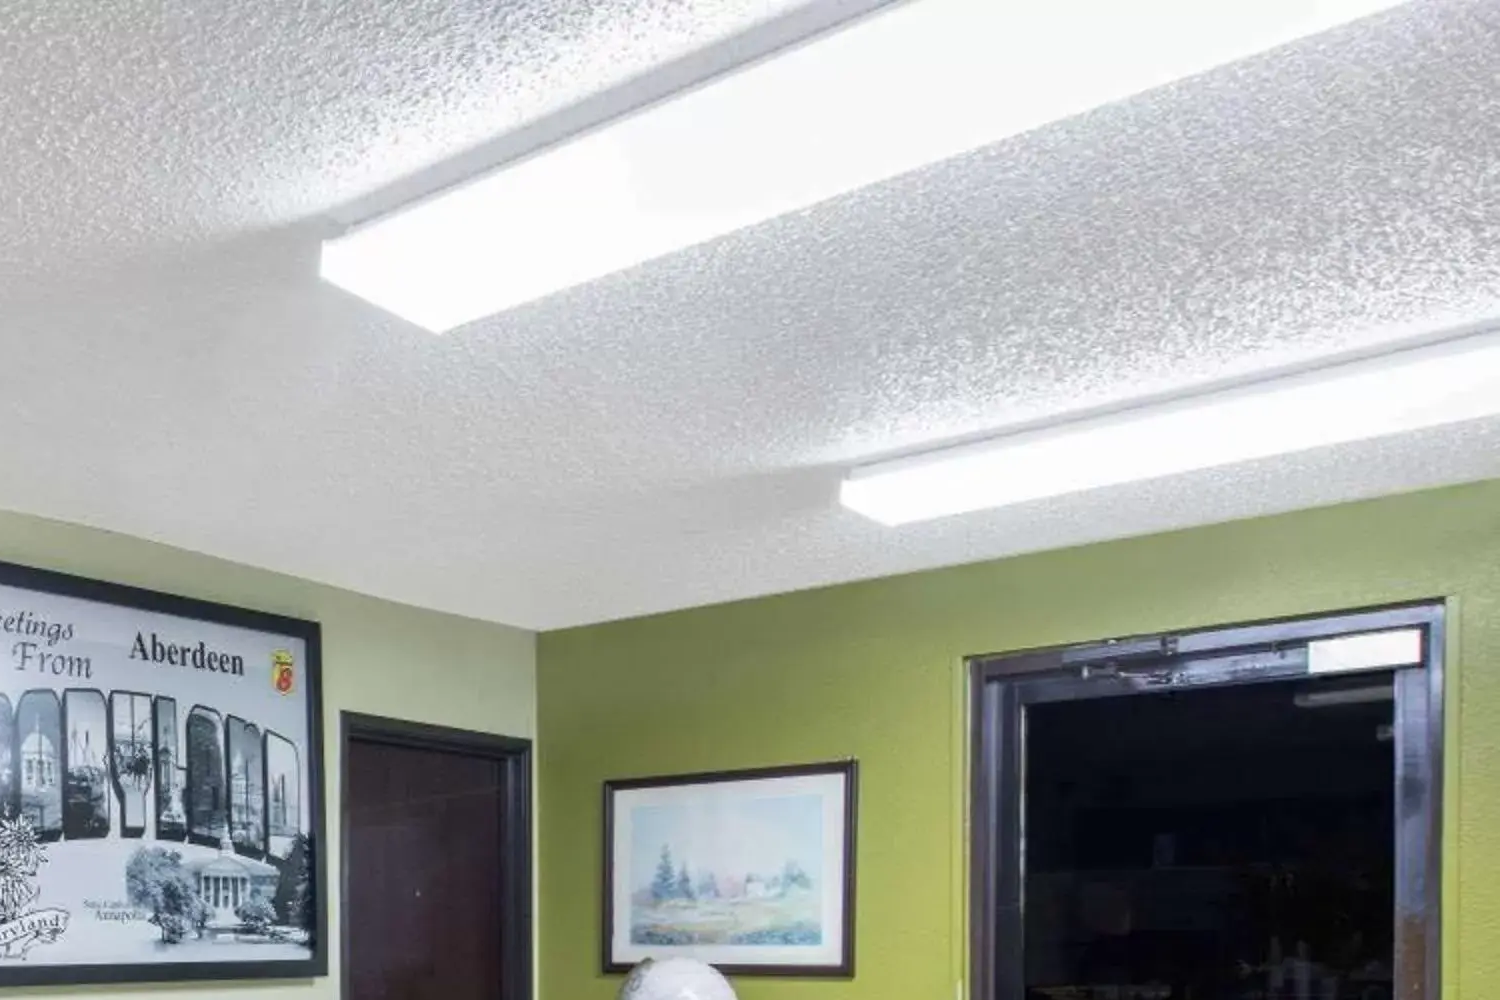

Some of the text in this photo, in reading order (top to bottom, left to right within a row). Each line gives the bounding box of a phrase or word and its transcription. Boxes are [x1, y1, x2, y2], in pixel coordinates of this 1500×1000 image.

[12, 641, 93, 679] From
[129, 631, 244, 676] Aberdeen
[276, 667, 293, 692] 8
